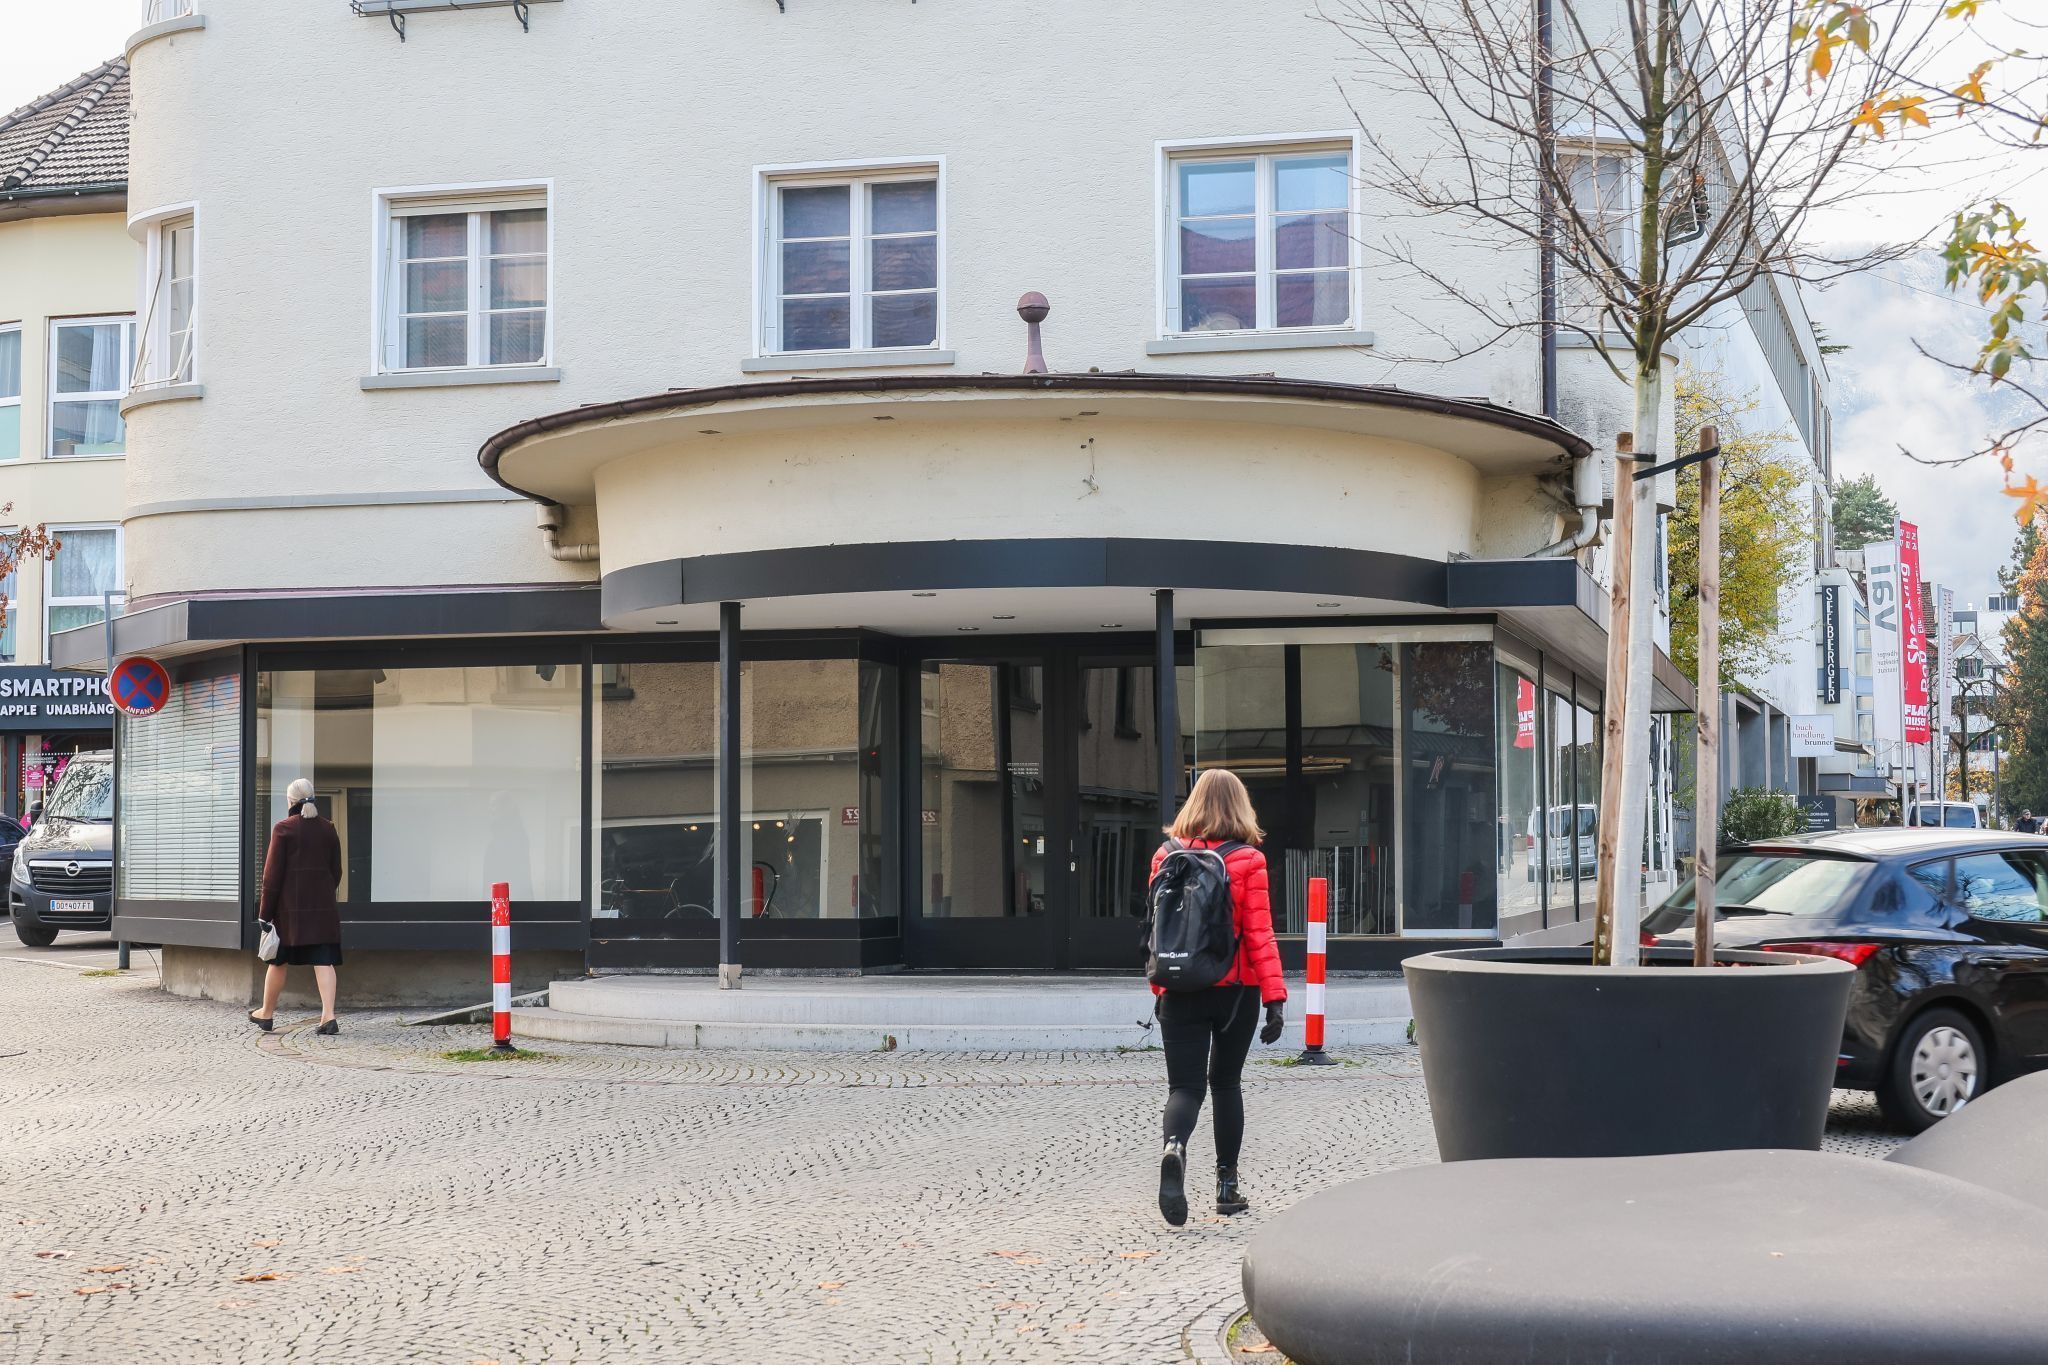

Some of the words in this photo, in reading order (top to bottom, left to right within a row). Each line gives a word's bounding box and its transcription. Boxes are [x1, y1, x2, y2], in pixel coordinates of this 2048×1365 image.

[1825, 588, 1835, 702] SEEBERGER
[0, 705, 37, 716] APPLE
[125, 706, 156, 714] ANFANG
[1792, 731, 1825, 739] handlung
